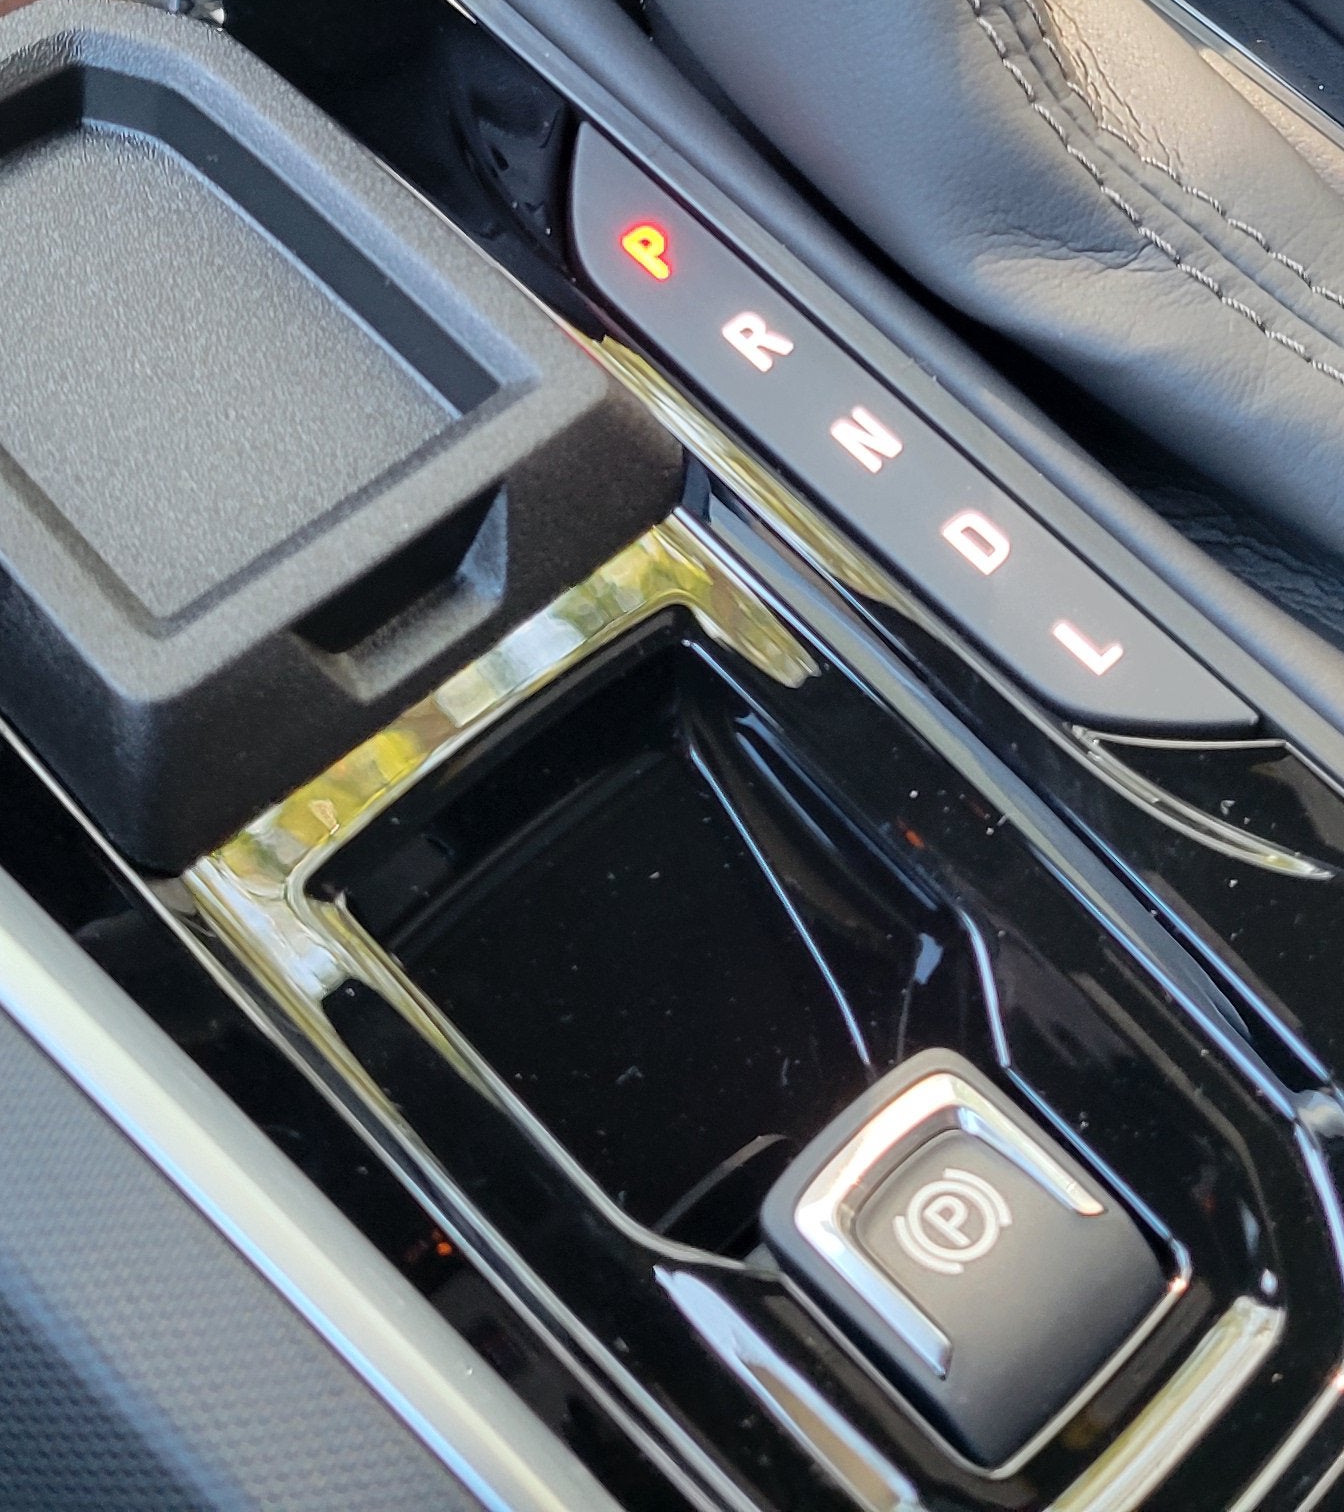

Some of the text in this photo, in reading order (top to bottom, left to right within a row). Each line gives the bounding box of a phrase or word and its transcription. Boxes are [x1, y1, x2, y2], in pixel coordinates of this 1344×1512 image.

[619, 220, 671, 281] P
[722, 312, 794, 373] R
[830, 406, 903, 474] N
[941, 509, 1011, 576] D
[1052, 620, 1124, 676] L
[922, 1193, 972, 1248] P
